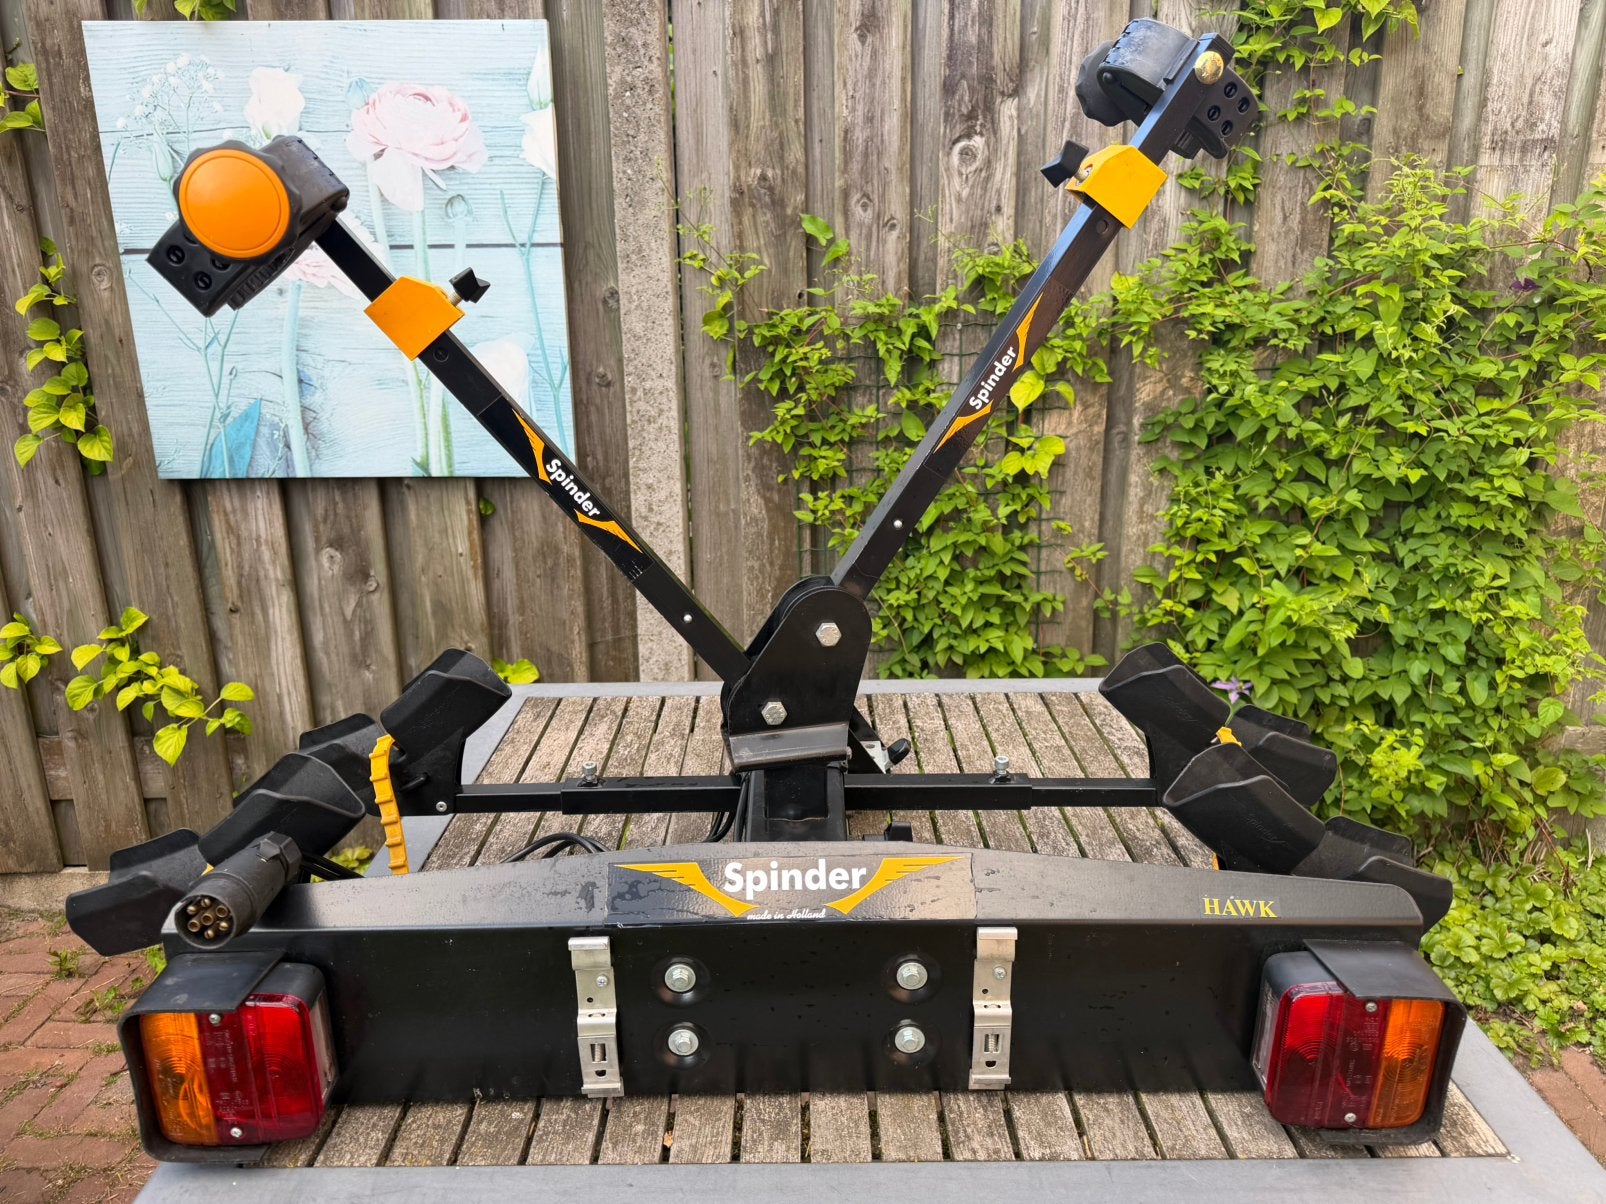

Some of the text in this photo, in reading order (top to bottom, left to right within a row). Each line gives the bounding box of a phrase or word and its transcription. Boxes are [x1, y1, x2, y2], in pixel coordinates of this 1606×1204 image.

[969, 346, 1016, 410] Spinder
[545, 459, 600, 517] Spinder
[723, 858, 867, 900] Spinder
[746, 908, 826, 920] made in Holland
[1202, 897, 1278, 918] HAWK
